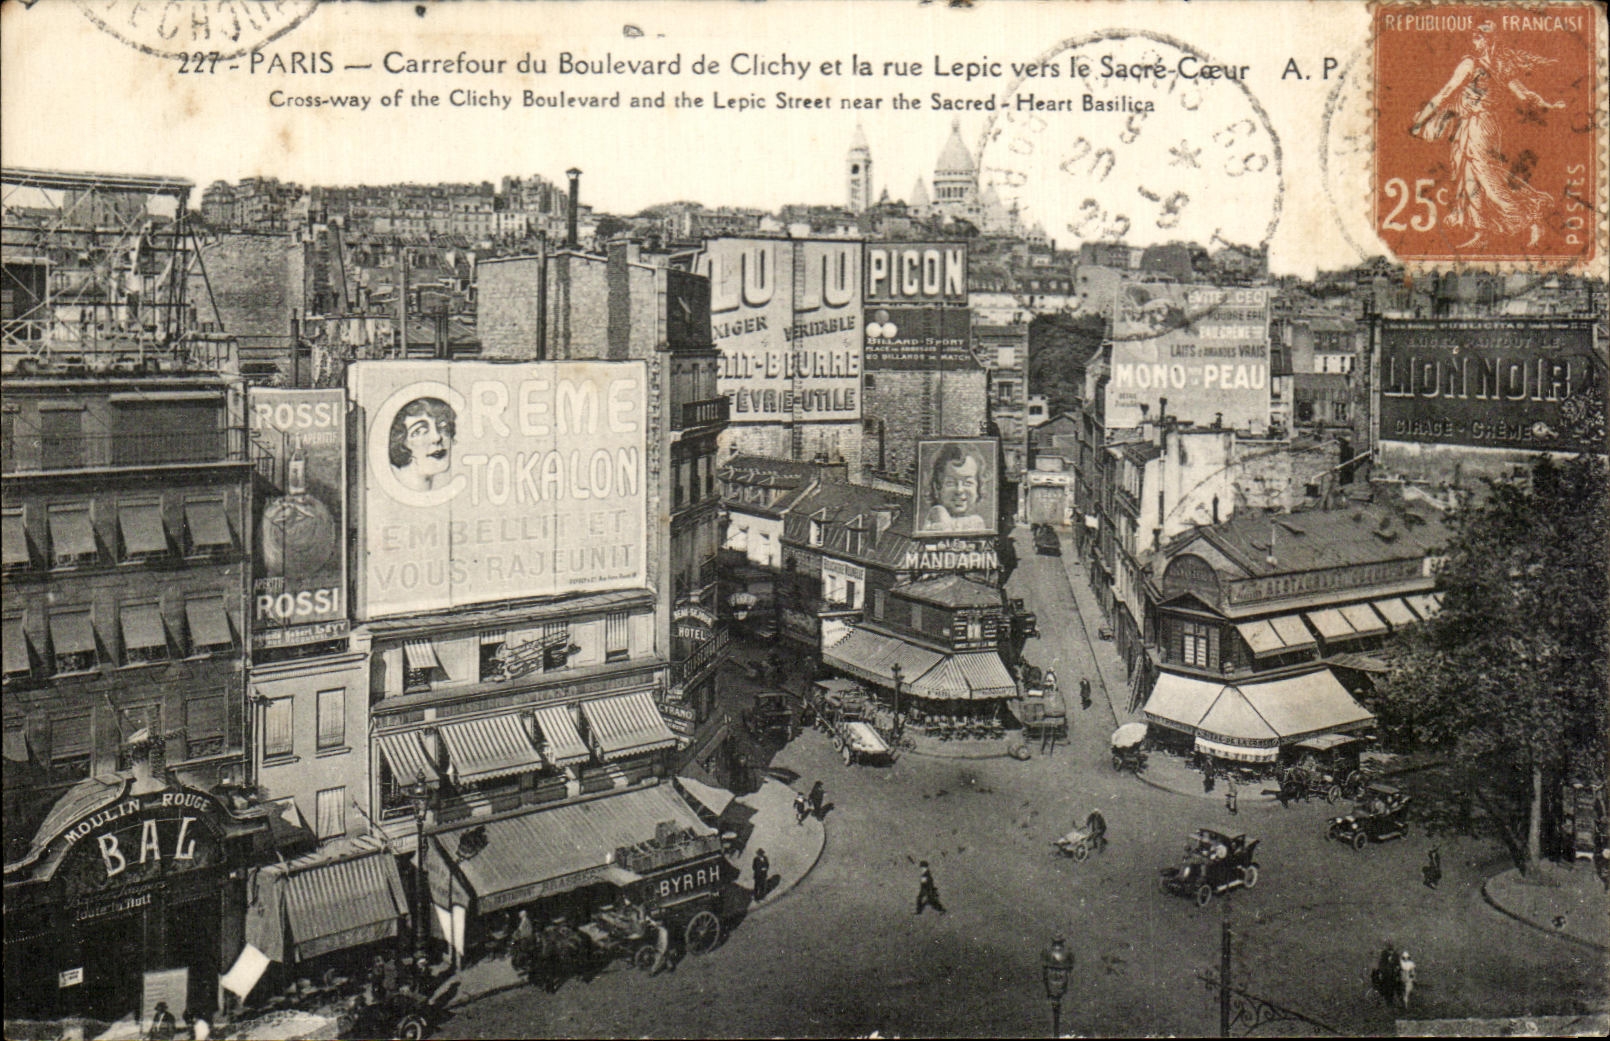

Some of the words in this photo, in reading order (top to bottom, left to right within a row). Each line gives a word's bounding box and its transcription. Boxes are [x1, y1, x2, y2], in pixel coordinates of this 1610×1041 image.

[869, 248, 963, 297] PICON
[1116, 363, 1186, 389] MONO
[1204, 363, 1266, 389] PEAU
[255, 402, 338, 430] ROSSI
[462, 446, 639, 508] TOKALON
[382, 511, 571, 553] EMBELLIT
[589, 508, 627, 538] ET
[372, 557, 468, 593] VOUS
[486, 543, 636, 579] RAJEUNIT
[905, 551, 998, 570] MANDARIN
[256, 588, 339, 620] ROSSI
[658, 702, 694, 721] CYRANO
[64, 798, 141, 847] MOULIN
[162, 792, 211, 812] ROUGE
[98, 815, 198, 877] BAL
[658, 863, 721, 898] BYRRH
